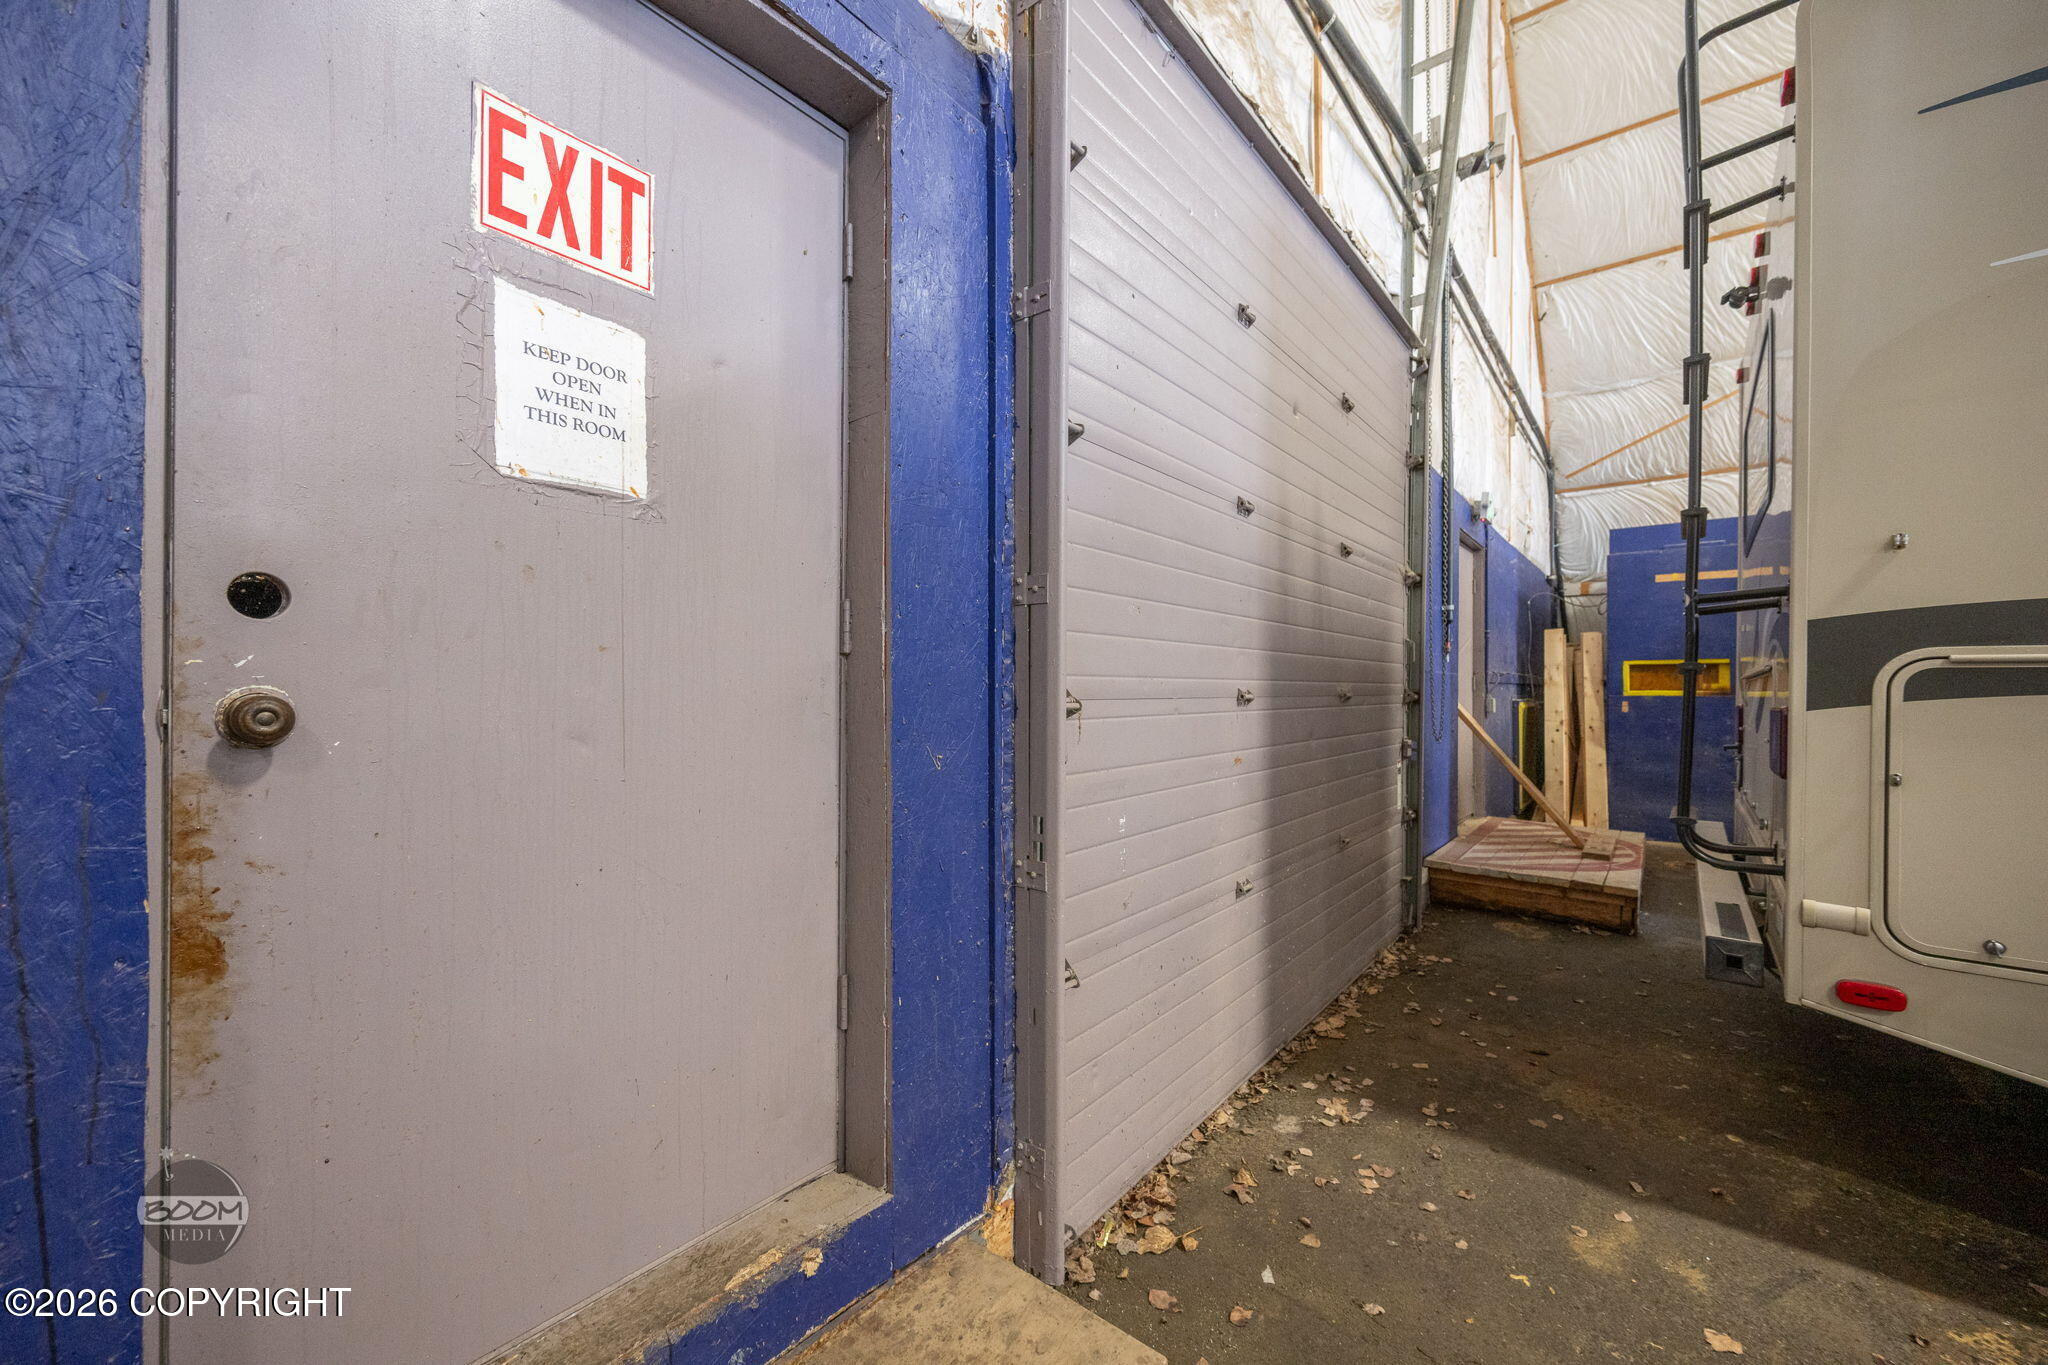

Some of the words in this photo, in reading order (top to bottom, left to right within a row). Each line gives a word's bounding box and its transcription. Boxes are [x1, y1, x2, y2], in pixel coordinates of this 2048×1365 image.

[488, 106, 645, 273] EXIT
[523, 340, 571, 365] KEEP
[576, 356, 628, 384] DOOR
[552, 371, 602, 396] OPEN
[535, 386, 594, 413] WHEN
[598, 403, 617, 420] IN
[523, 405, 568, 428] THIS
[572, 417, 627, 442] ROOM
